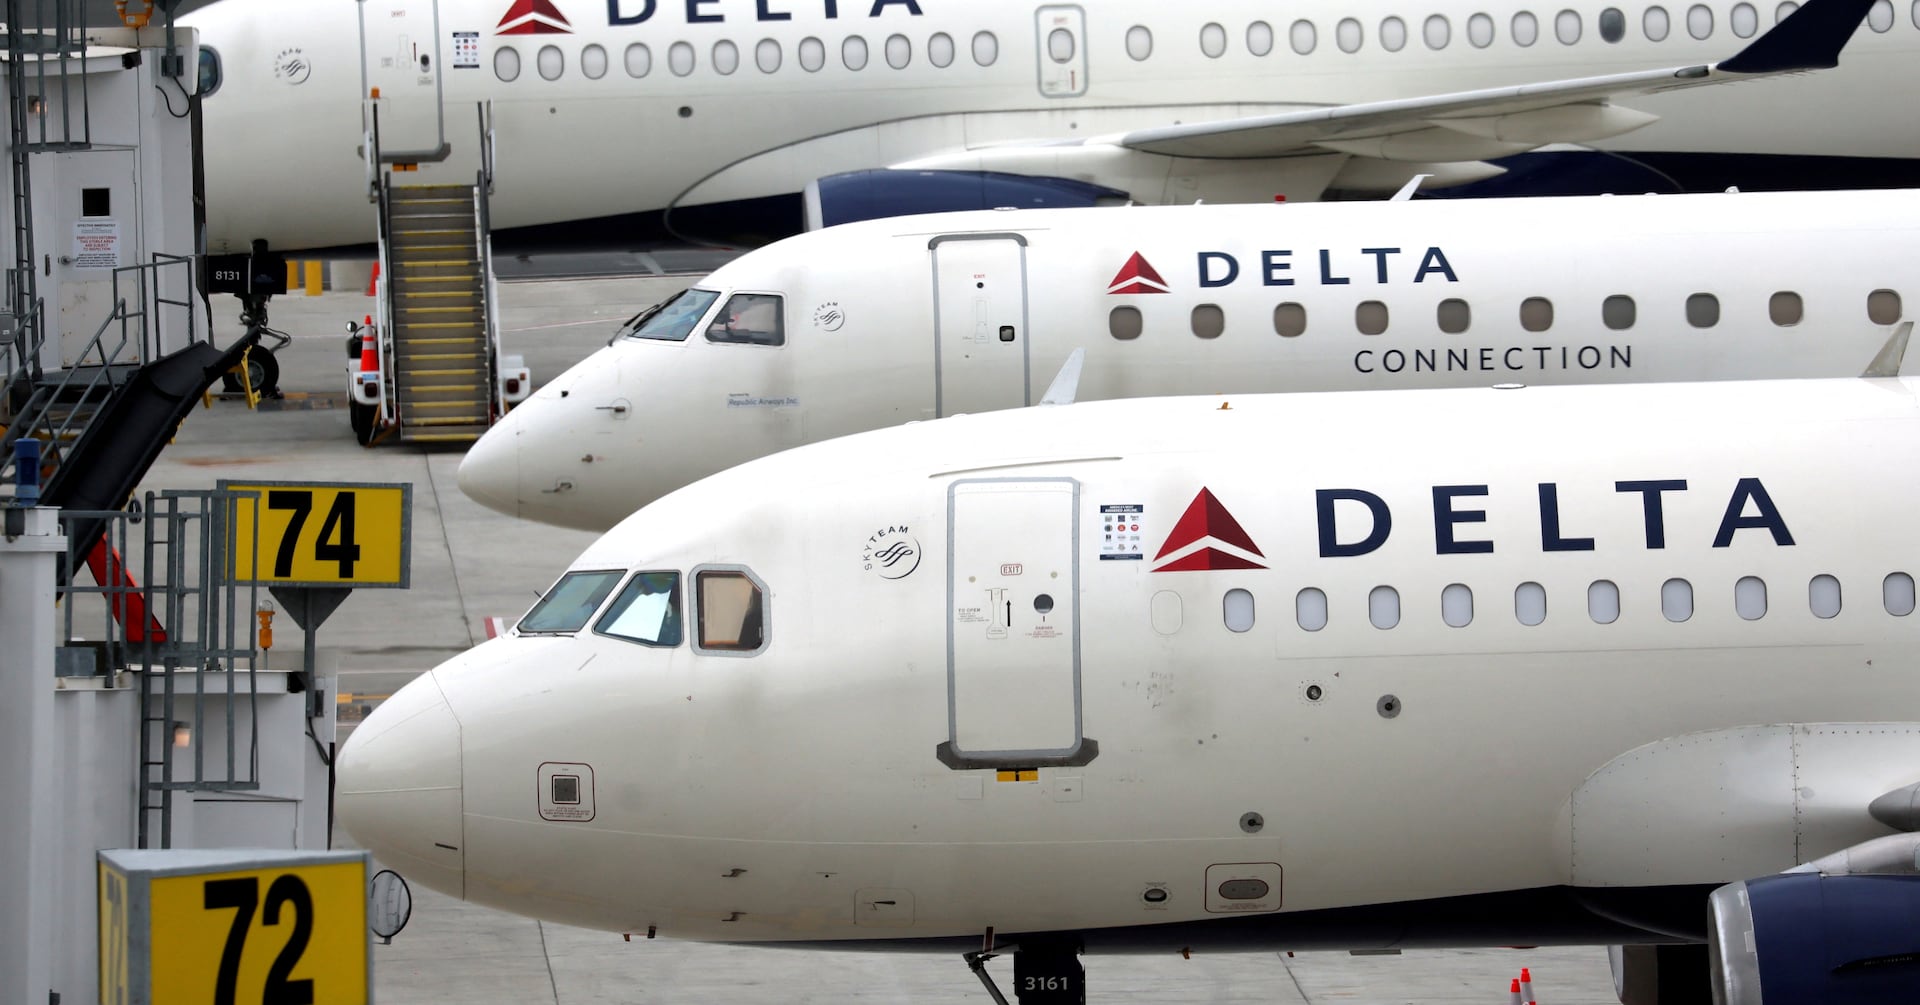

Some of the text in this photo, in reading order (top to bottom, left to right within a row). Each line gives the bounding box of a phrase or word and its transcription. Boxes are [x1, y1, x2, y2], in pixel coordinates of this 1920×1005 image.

[215, 270, 240, 281] 8131
[1197, 246, 1459, 288] DELTA
[1354, 345, 1632, 374] CONNECTION
[268, 490, 361, 579] 74
[1315, 477, 1797, 558] DELTA
[863, 525, 909, 571] SKYTEAM
[1003, 565, 1020, 574] EXIT
[204, 873, 314, 1005] 72
[1024, 976, 1068, 991] 3161
